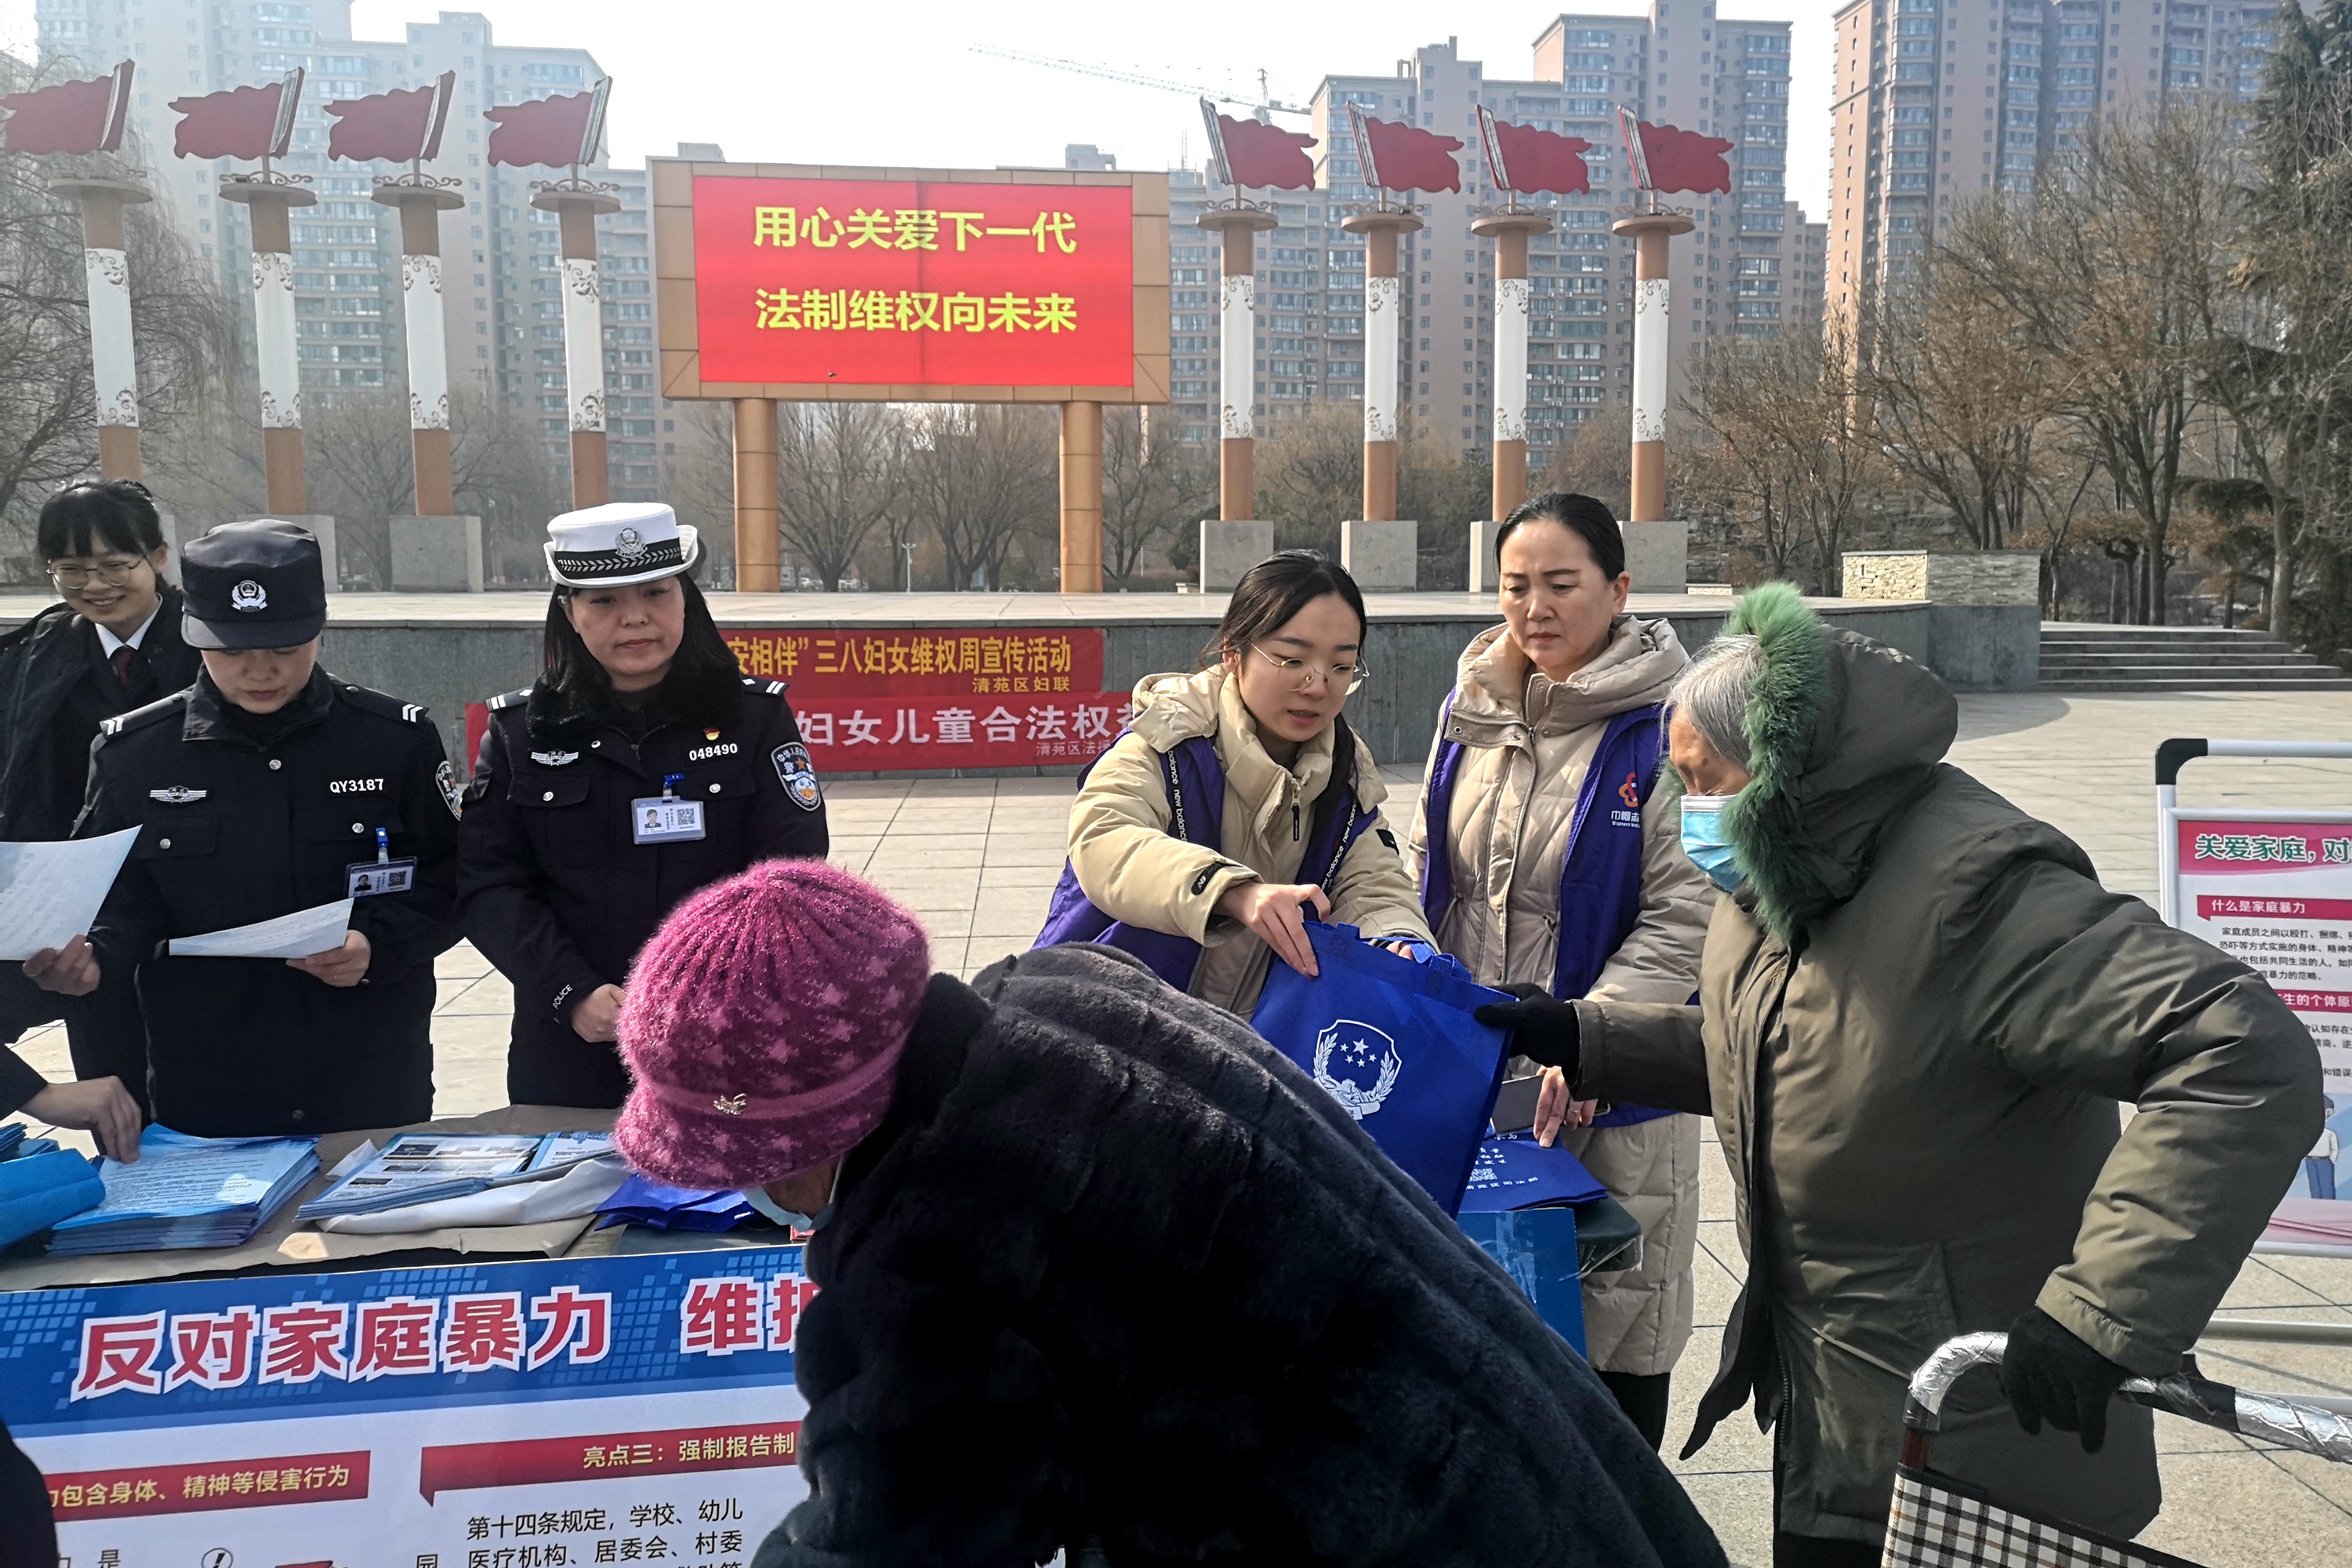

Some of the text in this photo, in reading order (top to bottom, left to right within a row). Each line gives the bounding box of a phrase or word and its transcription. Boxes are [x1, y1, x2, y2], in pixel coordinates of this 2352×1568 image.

[753, 206, 1077, 253] 用心关爱下一代
[754, 288, 1077, 333] 法制维权向未来
[972, 677, 1071, 694] 清苑区妇联
[795, 702, 1133, 746] 妇女儿童合法权
[688, 742, 739, 761] 048490
[328, 778, 385, 794] QY3187
[1174, 789, 1182, 808] new
[1327, 845, 1345, 877] balance
[1342, 825, 1351, 843] new
[1348, 800, 1357, 826] balanc
[2195, 833, 2352, 863] 关爱家庭，对
[2211, 899, 2306, 914] 什么是家庭暴力
[552, 984, 574, 1010] POLICE
[2278, 993, 2352, 1008] 生的个体原
[2306, 1024, 2352, 1035] 认知存在
[72, 1287, 613, 1399] 反对家庭暴力
[583, 1432, 795, 1468] 亮点三：强制报告制
